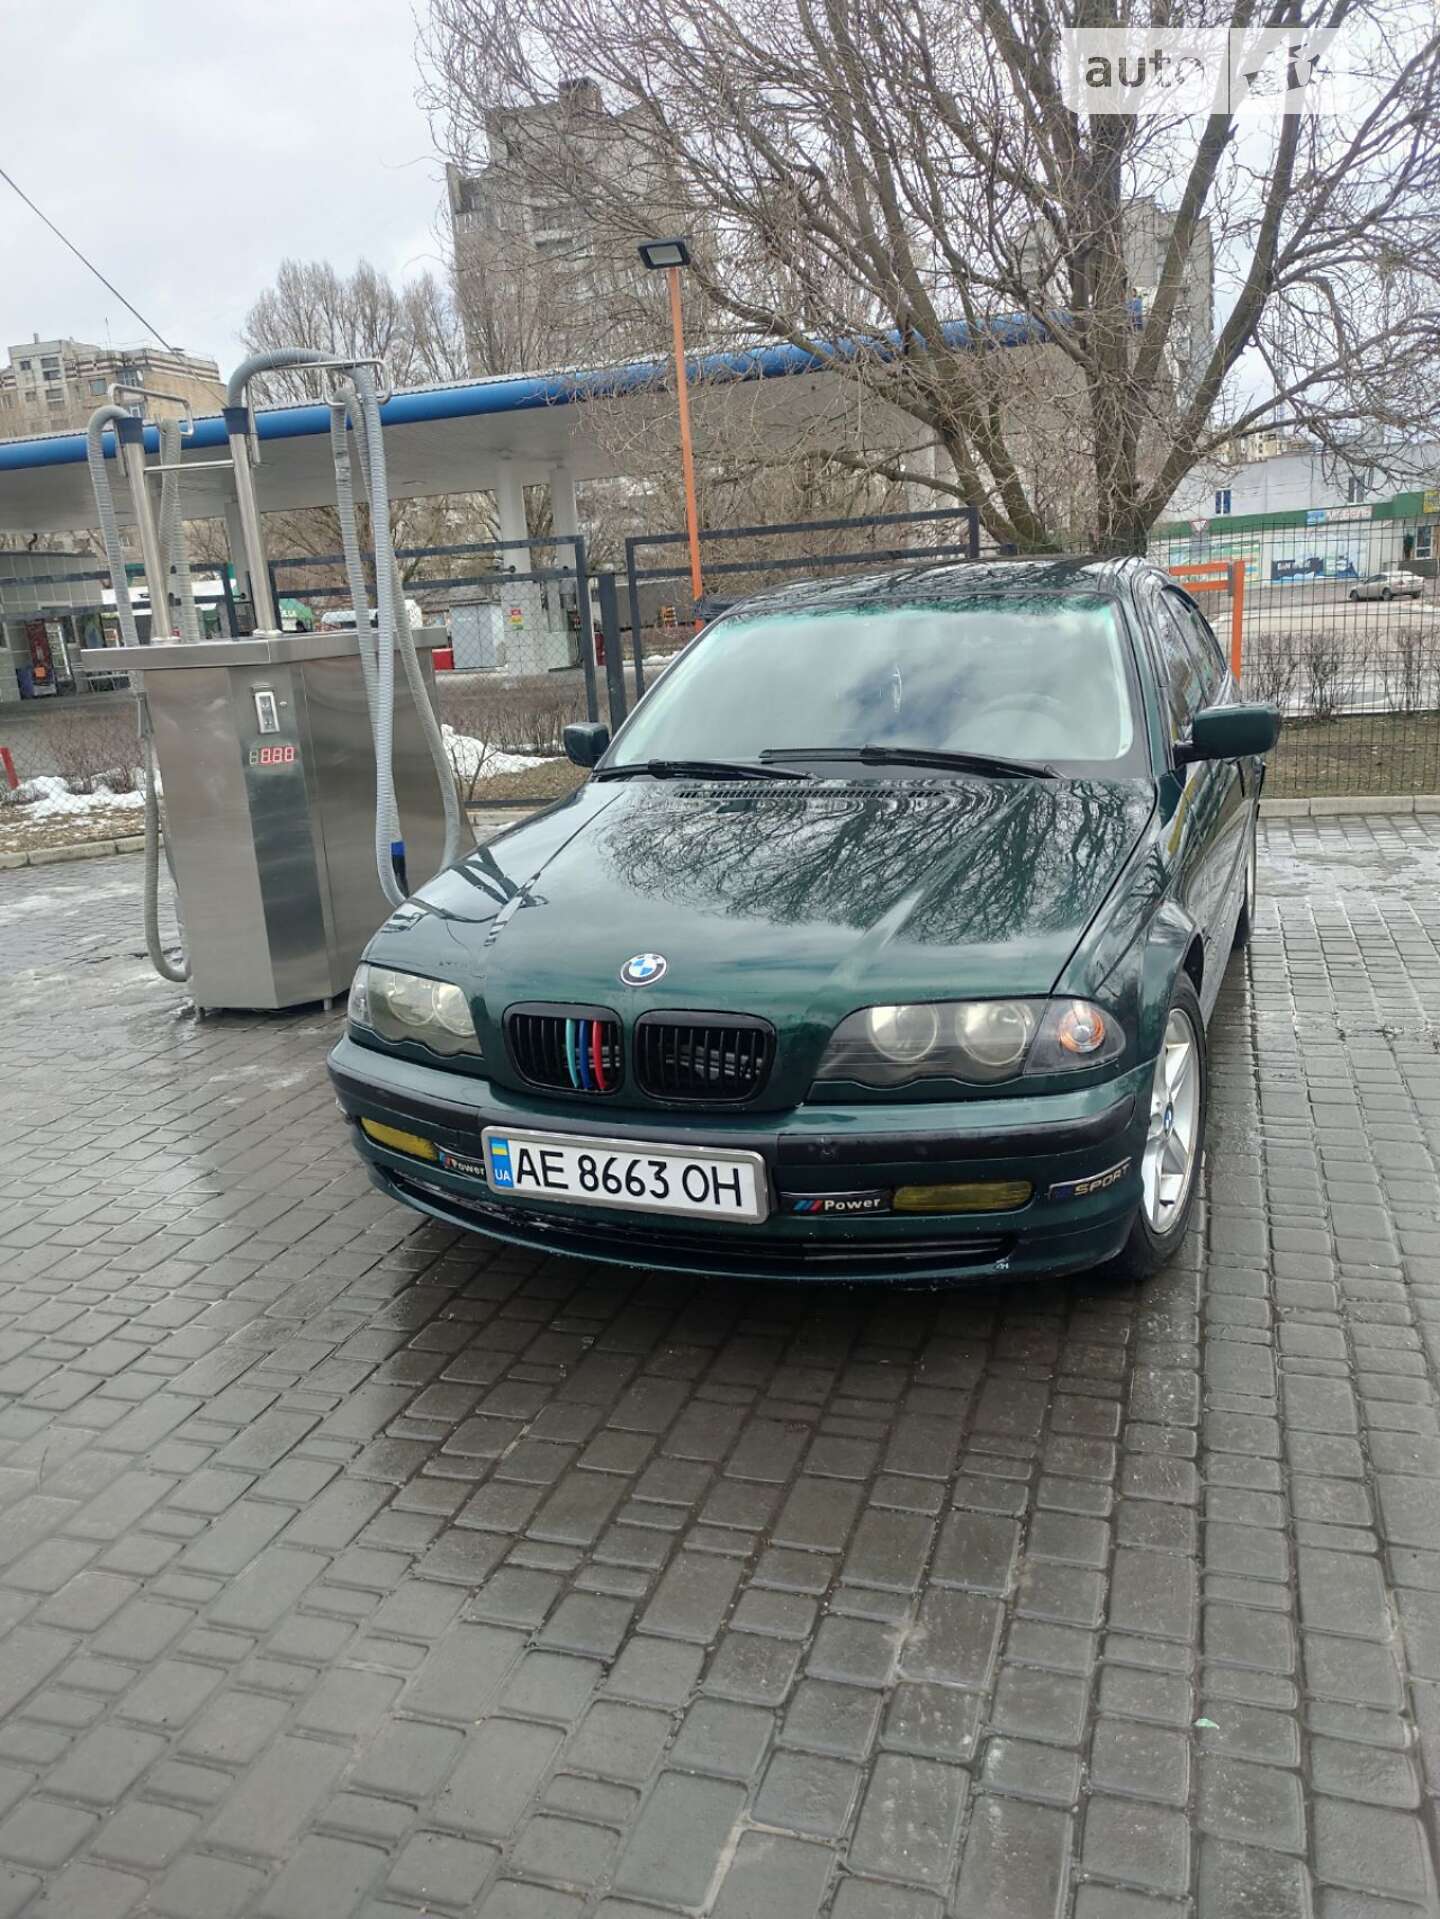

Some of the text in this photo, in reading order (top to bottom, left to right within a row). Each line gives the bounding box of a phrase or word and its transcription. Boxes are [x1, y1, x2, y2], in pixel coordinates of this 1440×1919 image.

[494, 1168, 511, 1181] UA
[516, 1148, 743, 1207] AE 8663 OH
[1073, 1163, 1131, 1196] SPORT
[824, 1198, 881, 1211] Power
